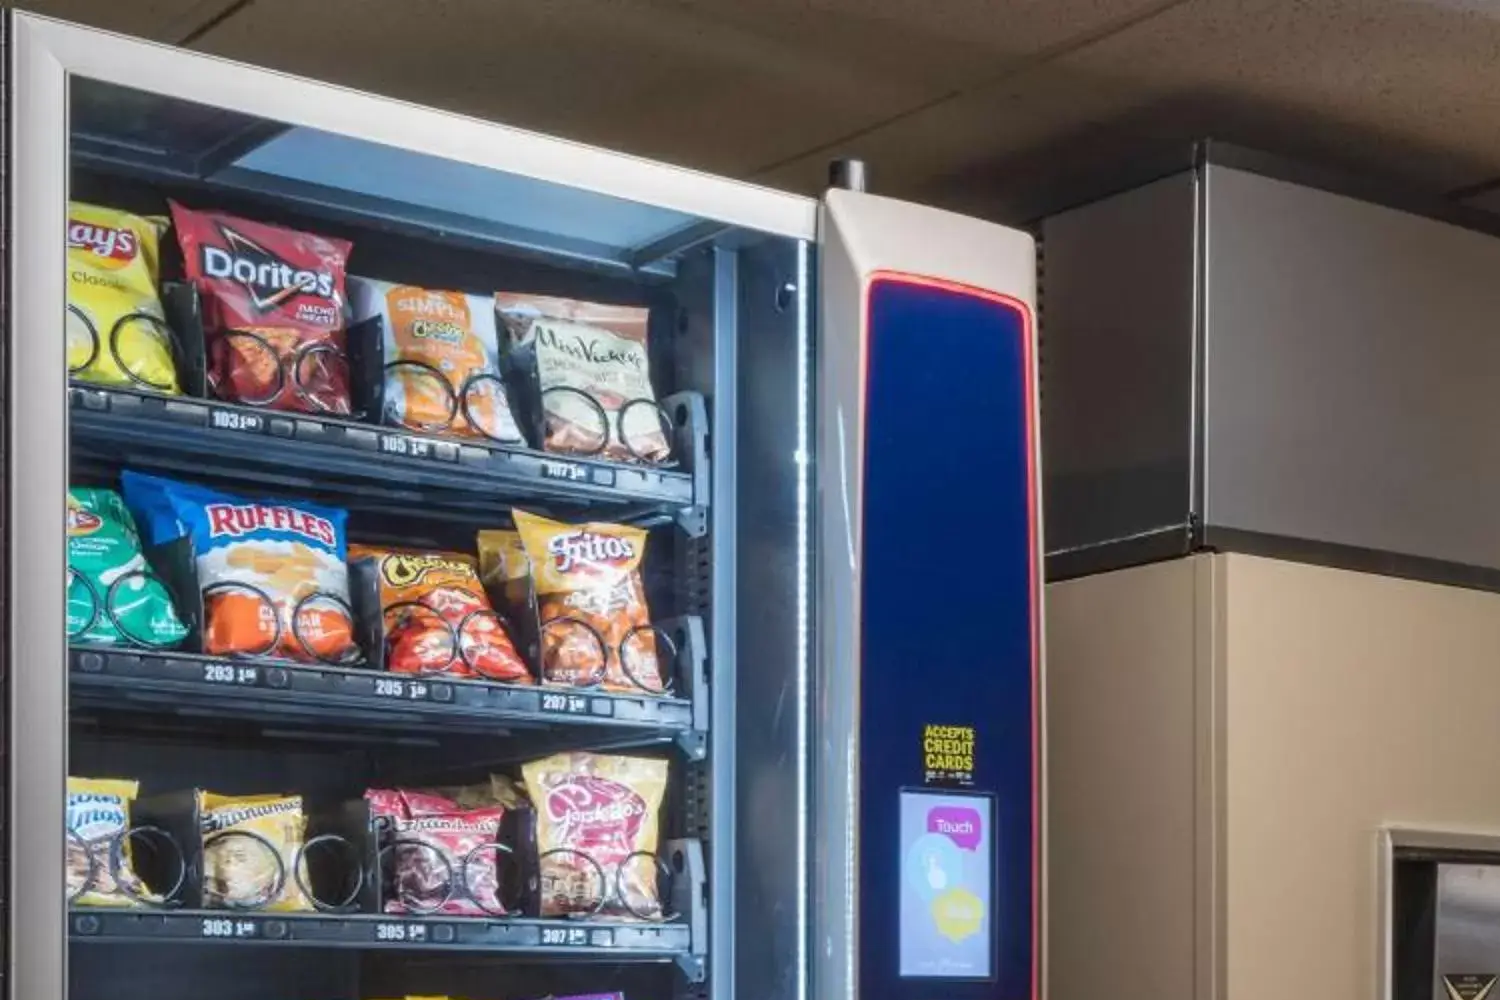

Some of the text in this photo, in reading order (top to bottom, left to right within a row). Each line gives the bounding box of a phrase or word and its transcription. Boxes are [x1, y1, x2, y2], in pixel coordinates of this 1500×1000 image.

[67, 224, 133, 257] ay's
[203, 247, 333, 297] Doritos
[212, 411, 239, 428] 103
[381, 436, 407, 453] 105
[206, 504, 334, 543] RUFFLES
[548, 530, 633, 572] Fritos
[204, 665, 235, 682] 203
[375, 680, 403, 696] 205
[543, 696, 566, 710] 207
[925, 726, 974, 741] ACCEPTS
[924, 738, 974, 755] CREDIT
[926, 754, 973, 770] CARDS
[936, 820, 973, 834] Touch
[202, 920, 233, 937] 303
[376, 924, 405, 940] 305
[543, 929, 566, 944] 307
